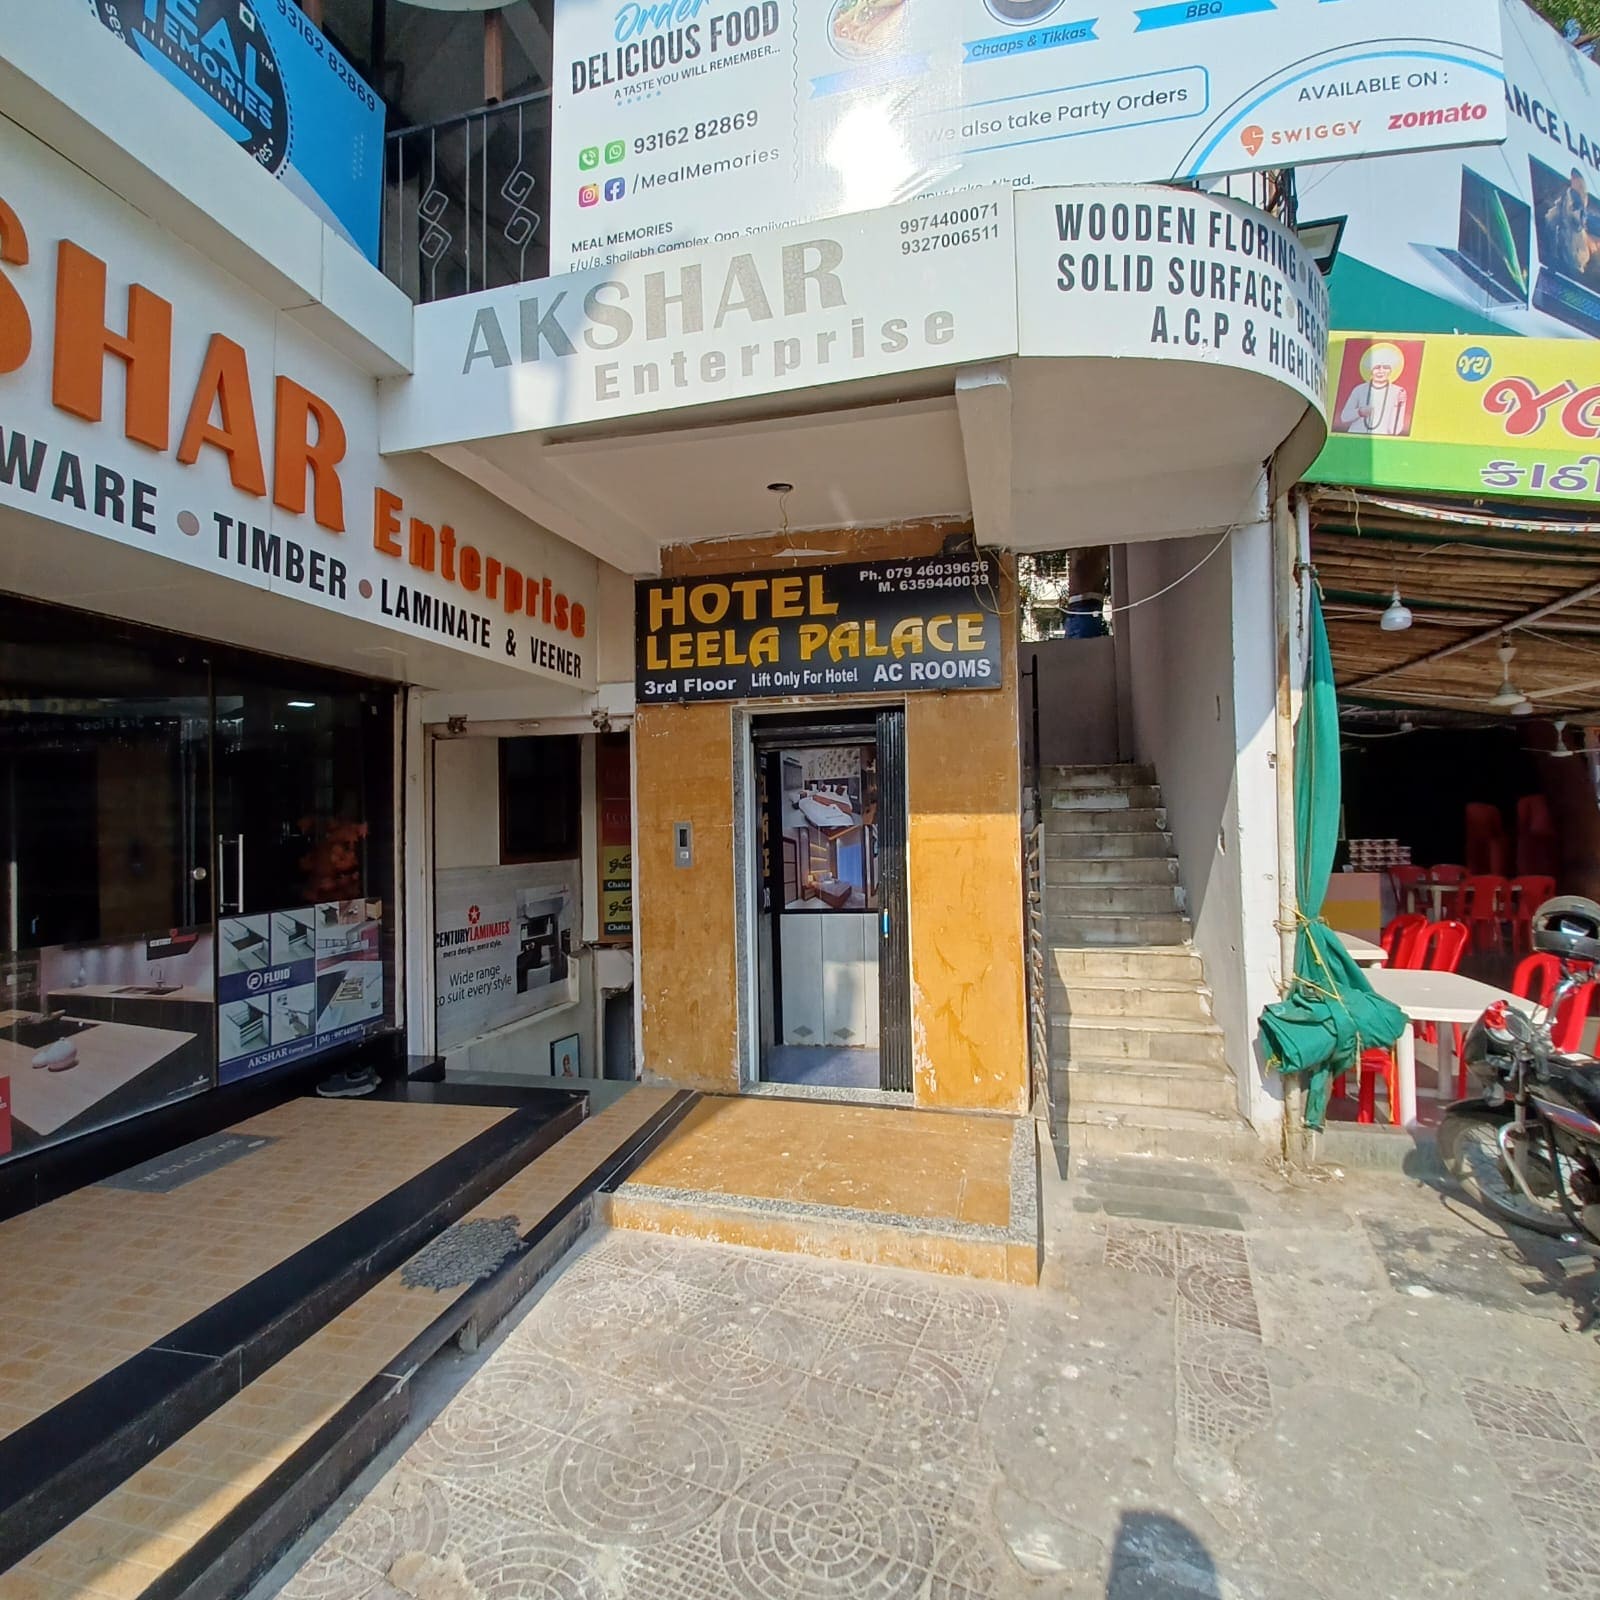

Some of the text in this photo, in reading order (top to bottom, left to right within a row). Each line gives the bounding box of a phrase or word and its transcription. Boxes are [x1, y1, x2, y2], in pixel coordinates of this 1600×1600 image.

[1185, 0, 1223, 19] BBQ
[276, 0, 376, 113] 93162 82869
[571, 0, 780, 95] DELICIOUS FOOD
[971, 25, 1087, 59] Chaaps & Tikkas
[614, 44, 782, 100] A TASTE YOU WILL REMEMBER...
[1298, 76, 1401, 103] AVAILABLE
[1407, 72, 1438, 89] ON
[960, 119, 1003, 138] also
[1007, 110, 1052, 130] take
[1058, 100, 1112, 121] Party
[1116, 87, 1188, 111] Orders
[1387, 101, 1488, 131] zomato
[633, 109, 759, 155] 93162 82869
[1270, 119, 1363, 146] SWIGGY
[900, 202, 999, 235] 9974400071
[571, 221, 674, 253] MEAL MEMORIES
[900, 223, 999, 256] 9327006511
[1055, 202, 1196, 246] WOODEN
[1208, 209, 1297, 283] FLORING
[605, 245, 655, 266] Shailabh
[1056, 253, 1154, 293] SOLID
[1167, 256, 1283, 319] SURFACE
[462, 237, 848, 375] AKSHAR
[1150, 305, 1230, 349] A.C.P
[1241, 319, 1257, 357] &
[594, 309, 956, 403] Enterprise
[1458, 355, 1490, 375] જય
[373, 486, 586, 639] Enterprise
[859, 560, 989, 583] Ph. 079 46039656
[213, 510, 347, 600] TIMBER
[380, 577, 492, 649] LAMINATE
[505, 628, 517, 658] &
[529, 635, 582, 680] VEENER
[877, 573, 989, 593] M. 6359440039
[649, 574, 840, 633] HOTEL
[645, 626, 781, 671] LEELA
[798, 612, 987, 664] PALACE
[644, 677, 737, 695] 3rd Floor
[751, 667, 859, 689] Lift Only For Hotel
[872, 658, 991, 683] AC ROOMS
[263, 968, 291, 984] FLUID
[447, 987, 465, 1004] suit
[467, 981, 493, 998] every
[493, 974, 512, 991] style
[449, 964, 501, 987] Wide range
[248, 1047, 288, 1068] AKSHAR
